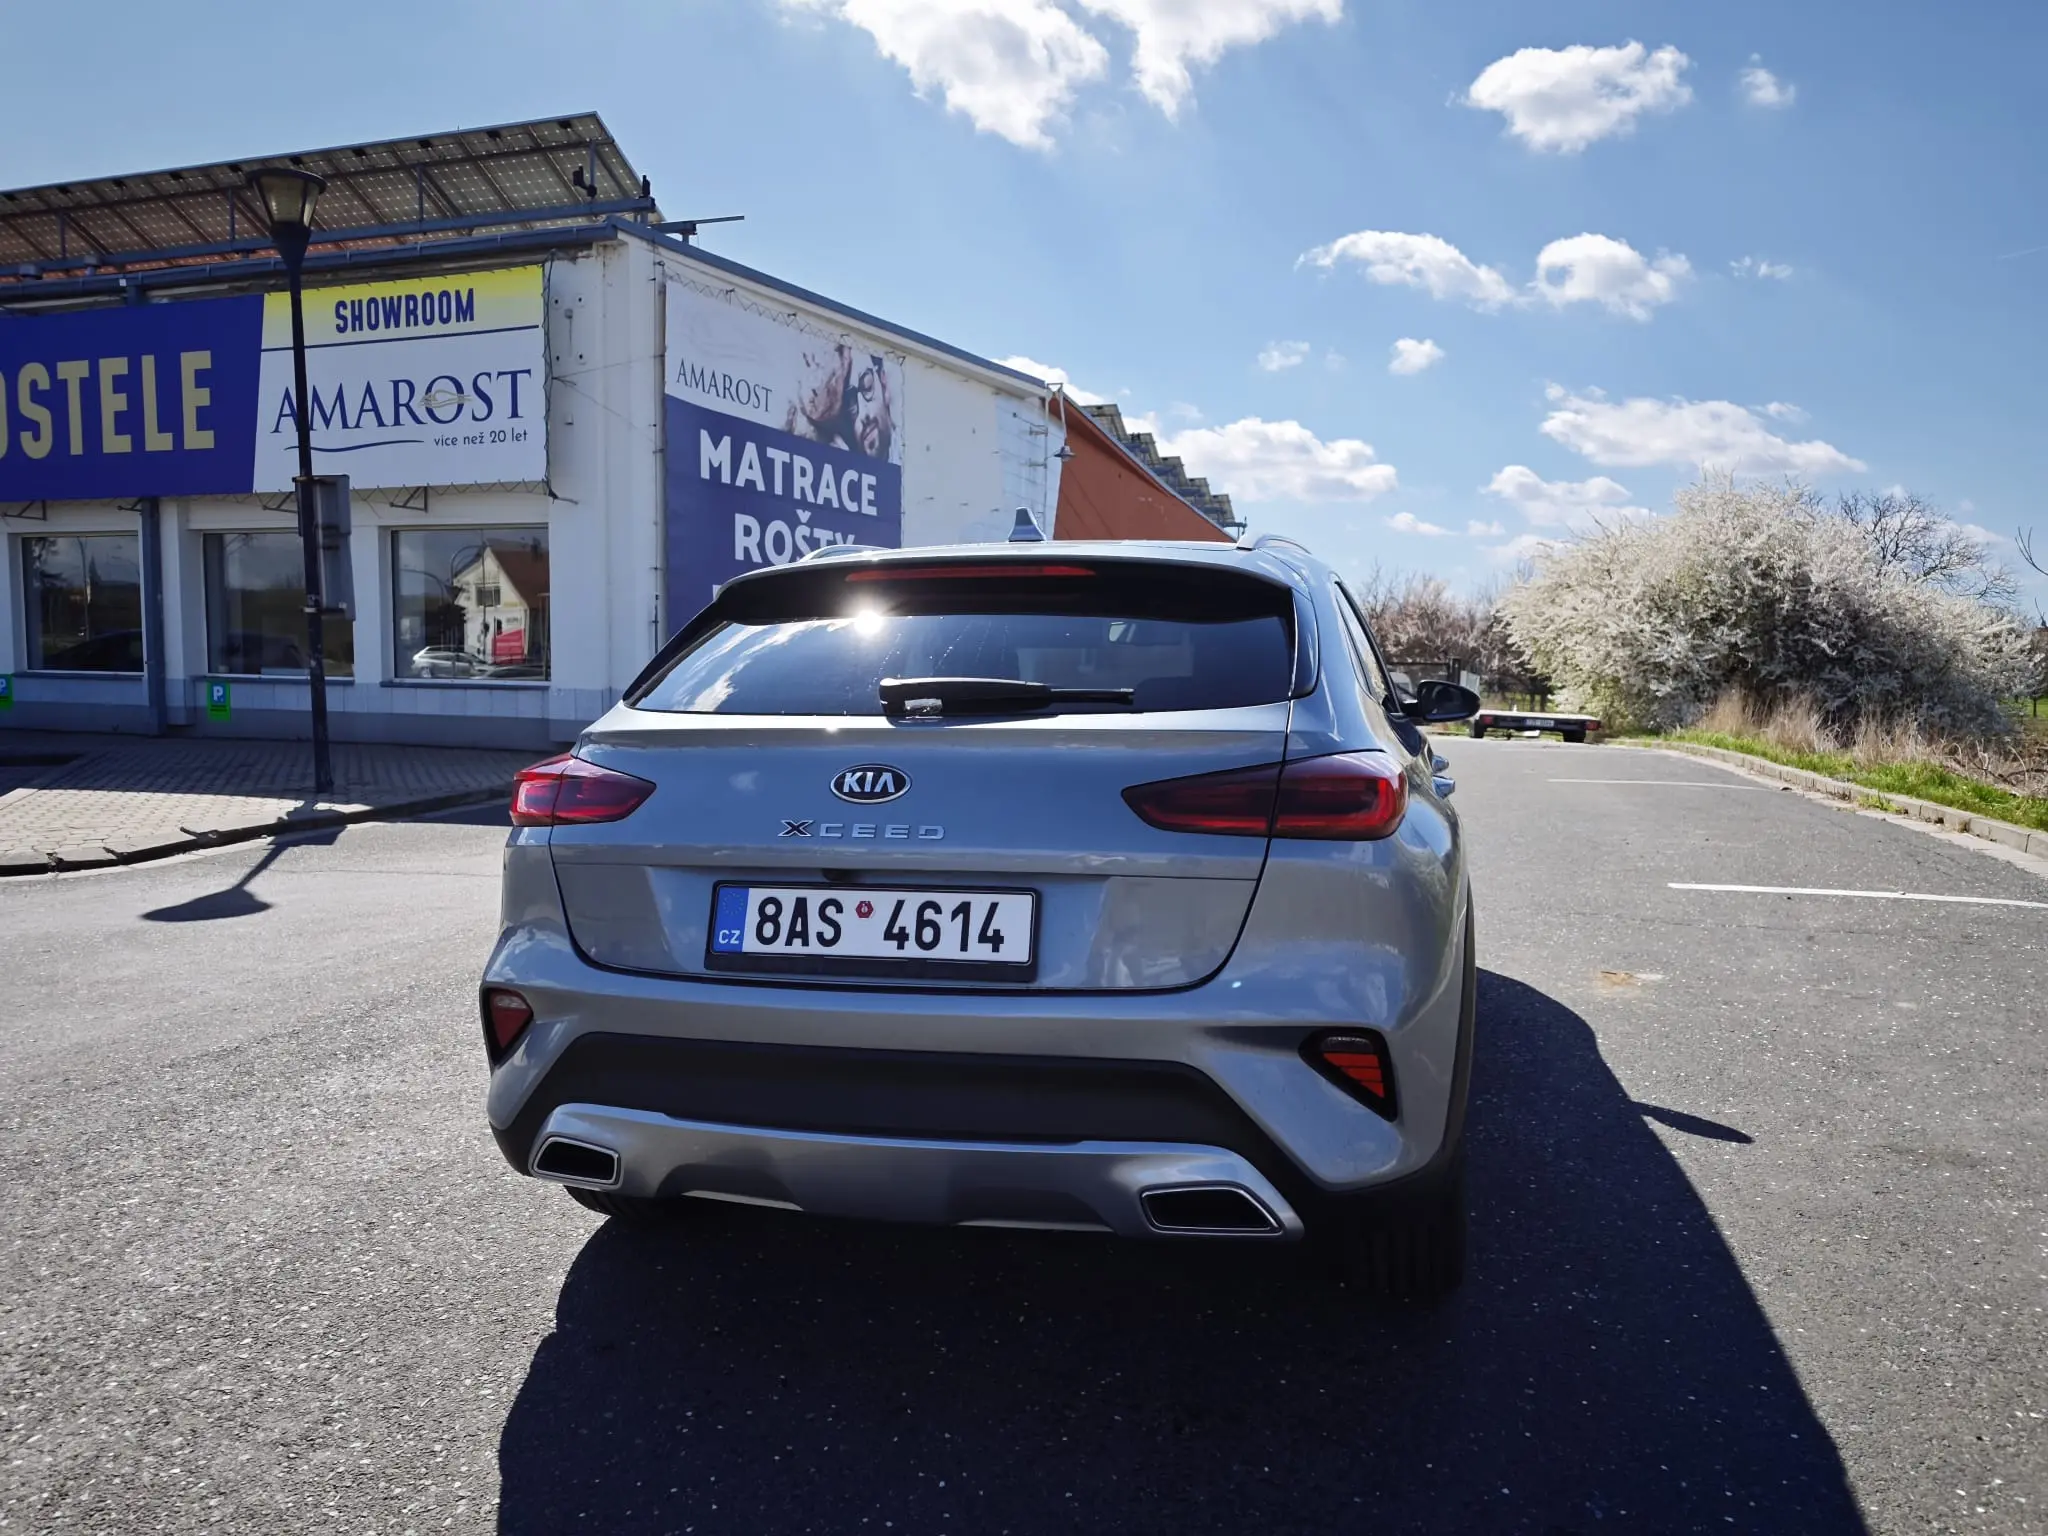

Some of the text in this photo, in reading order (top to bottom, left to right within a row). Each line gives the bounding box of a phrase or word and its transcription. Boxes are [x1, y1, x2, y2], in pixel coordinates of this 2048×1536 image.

[334, 287, 475, 334] SHOWROOM
[0, 350, 215, 460] STELE
[270, 368, 532, 434] AMAROST
[676, 358, 772, 412] AMAROST
[463, 431, 485, 445] než
[489, 429, 507, 443] 20
[511, 427, 528, 442] let
[700, 428, 878, 517] MATRACE
[734, 508, 856, 567] ROŠT
[842, 771, 896, 793] KIA
[777, 819, 946, 841] XCEED
[718, 929, 742, 945] CZ
[755, 896, 1005, 952] 8AS 4614
